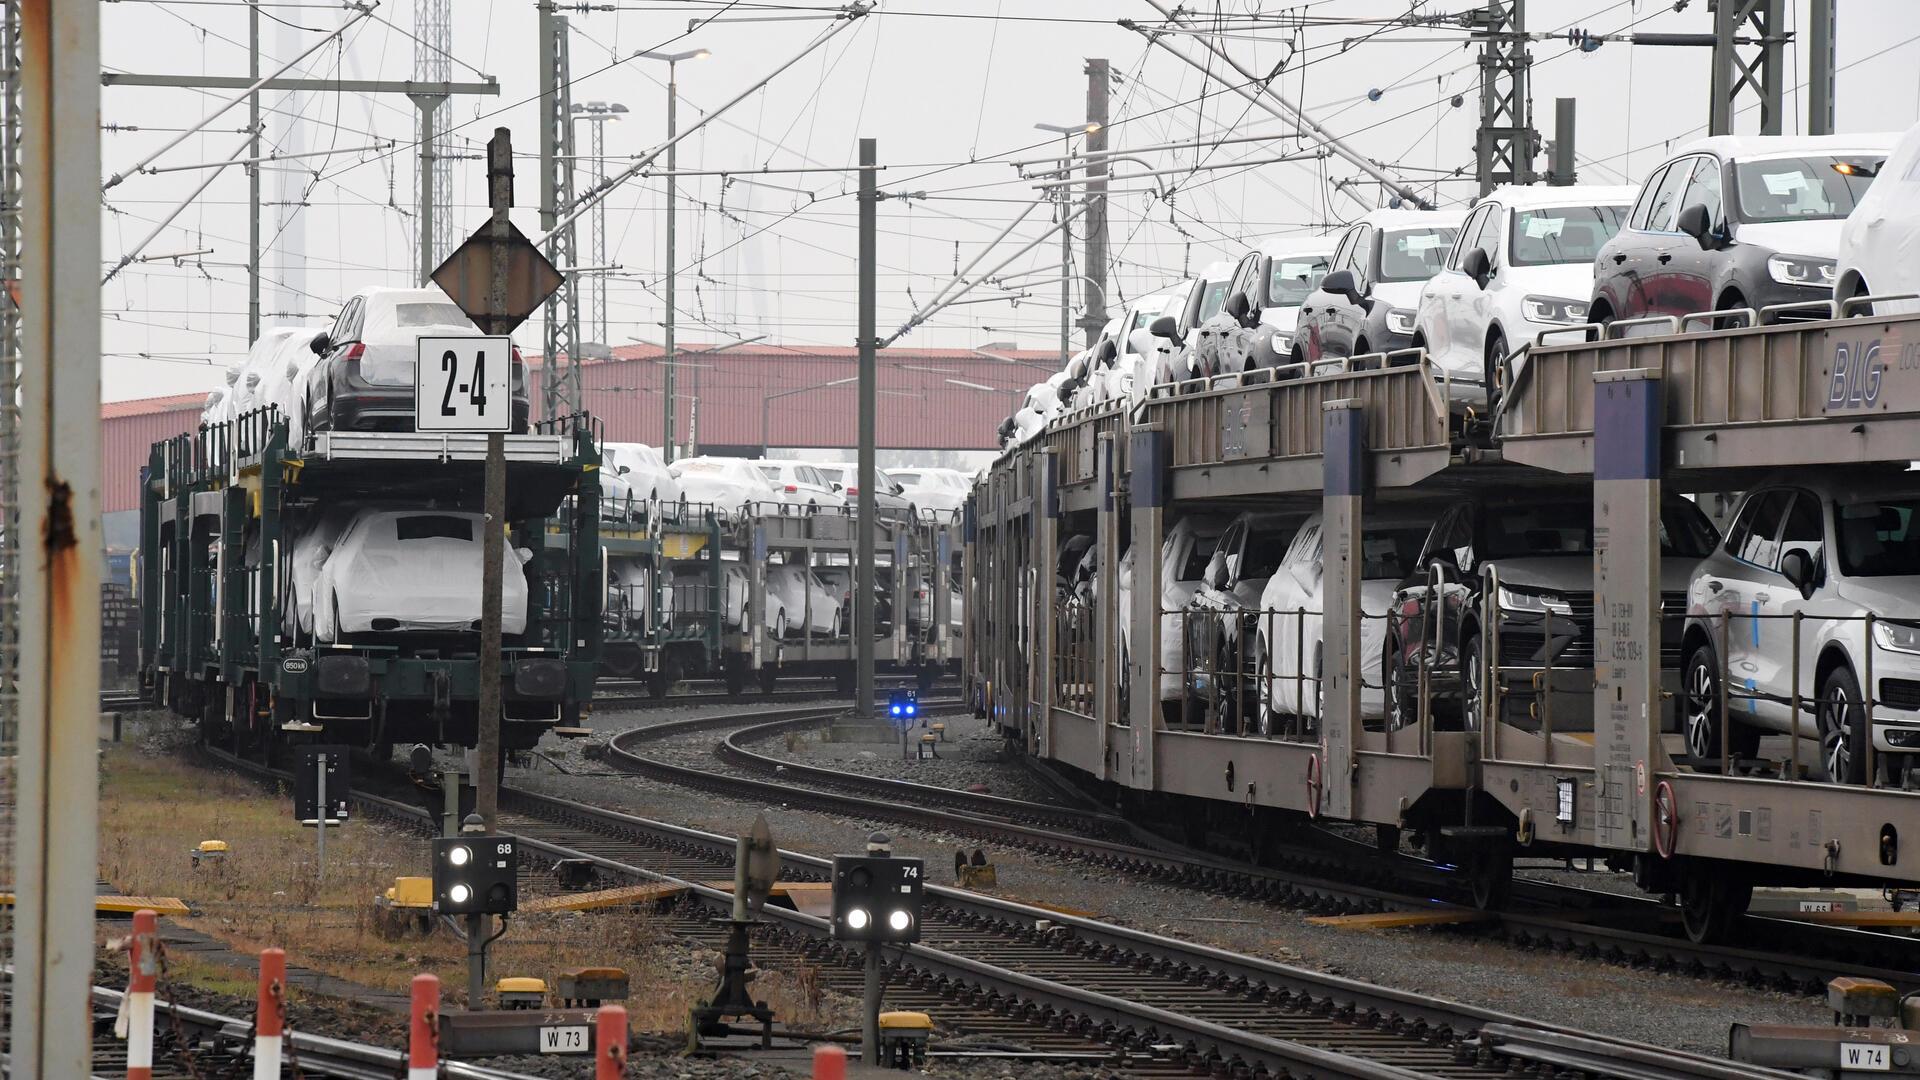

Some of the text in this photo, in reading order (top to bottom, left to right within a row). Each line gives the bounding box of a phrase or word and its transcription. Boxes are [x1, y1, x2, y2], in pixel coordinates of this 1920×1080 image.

[1827, 339, 1882, 409] BLG
[441, 350, 487, 416] 2-4
[907, 689, 915, 697] 61
[497, 844, 511, 854] 68
[902, 866, 917, 878] 74
[548, 1032, 580, 1047] W 73
[1849, 1049, 1882, 1065] W 74
